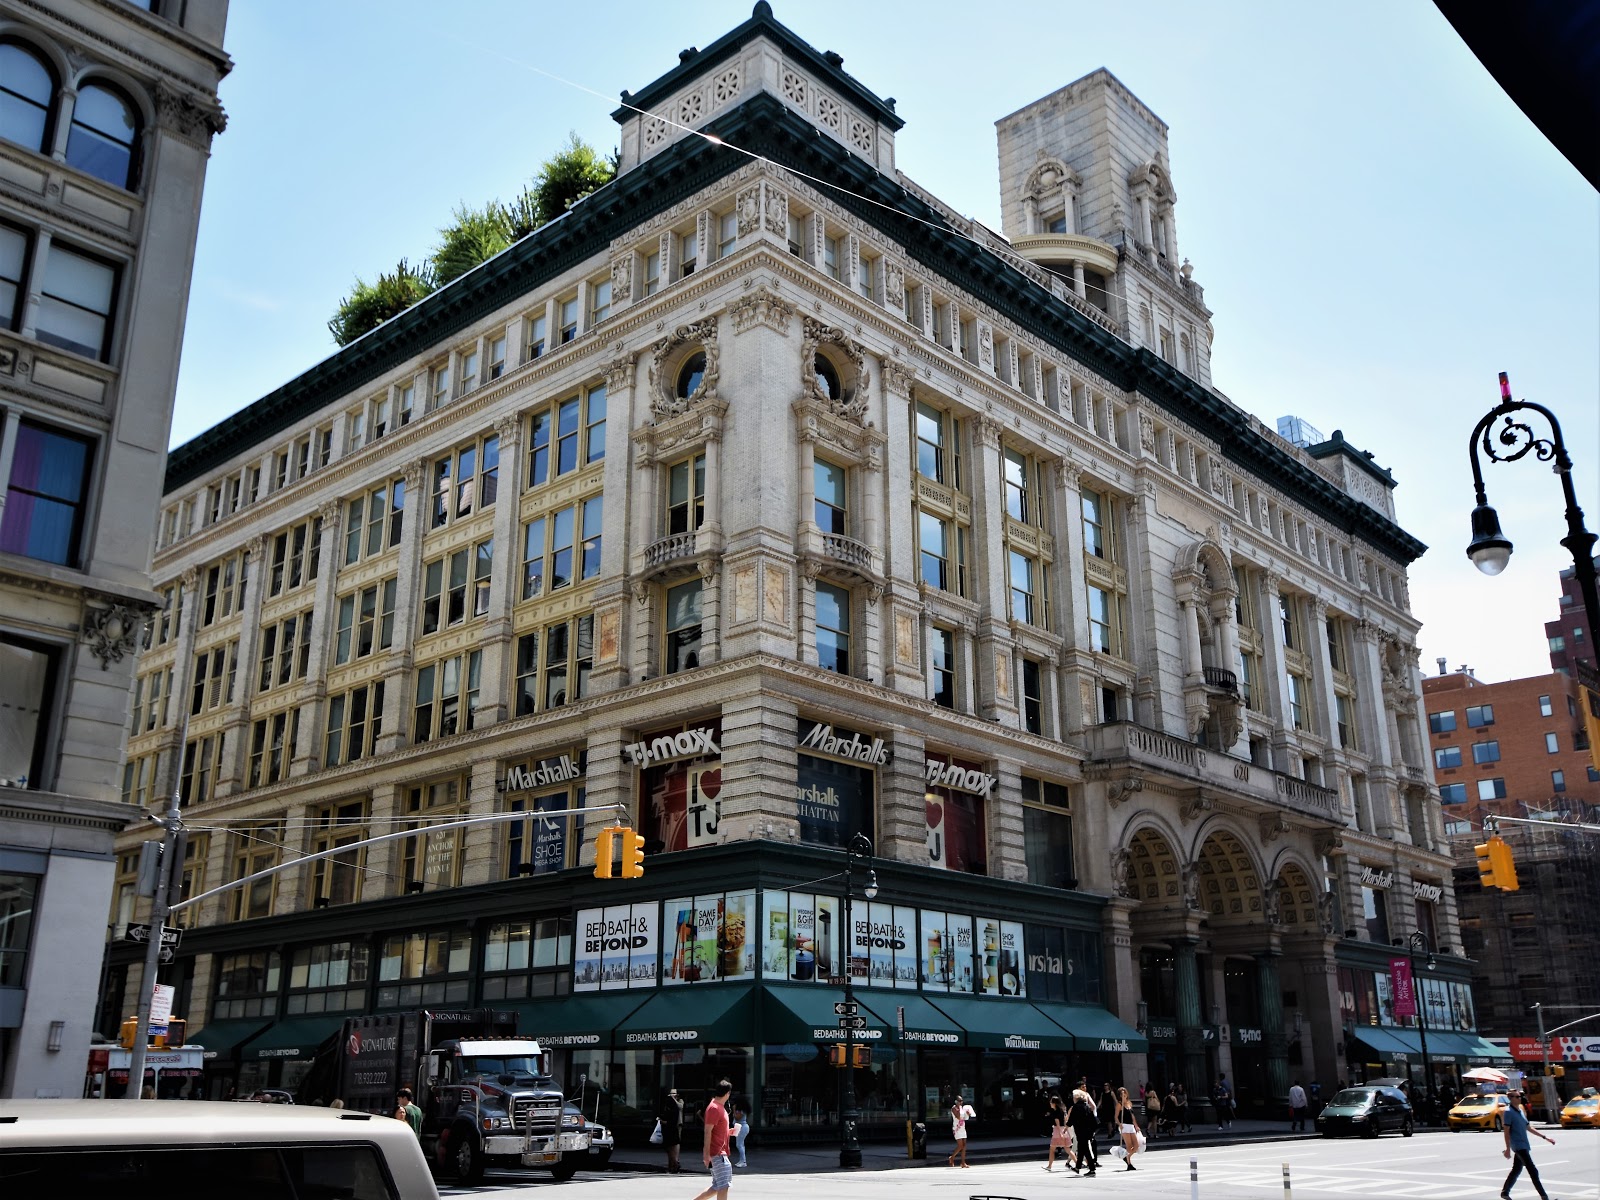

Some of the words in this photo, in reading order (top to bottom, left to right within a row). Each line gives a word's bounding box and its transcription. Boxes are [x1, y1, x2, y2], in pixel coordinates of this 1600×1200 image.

[800, 723, 889, 766] Marshalls
[506, 754, 580, 792] Marshalls
[1234, 763, 1249, 783] 620
[797, 784, 840, 807] arshalls
[797, 804, 840, 822] HATTAN
[537, 831, 562, 843] Marshalls
[427, 841, 454, 852] ANCHOR
[535, 842, 562, 859] SHOE
[427, 854, 437, 863] OF
[438, 851, 451, 861] THE
[534, 859, 548, 867] MEGA
[549, 856, 563, 864] SHOP
[426, 863, 451, 875] AVENUE
[1360, 867, 1394, 888] Marshalls
[698, 908, 716, 919] SAME
[796, 908, 814, 916] WEDDING
[586, 920, 607, 938] BED
[608, 918, 637, 937] BATH
[638, 916, 648, 933] &
[698, 917, 715, 927] DAY
[134, 929, 150, 937] ONE
[855, 920, 873, 935] BED
[873, 922, 897, 938] BATH
[897, 926, 905, 939] &
[957, 927, 971, 935] SAME
[855, 935, 906, 950] BEYOND
[957, 934, 970, 943] DAY
[1002, 933, 1014, 941] SHOP
[585, 935, 648, 952] BEYOND
[1028, 948, 1073, 975] rshals
[434, 1013, 472, 1021] SIGNATURE
[536, 1037, 545, 1045] BED
[545, 1037, 558, 1045] BATH
[563, 1035, 600, 1044] BEYOND
[626, 1033, 638, 1042] BED
[638, 1033, 652, 1042] BATH
[652, 1032, 657, 1041] &
[657, 1031, 698, 1041] BEYOND
[814, 1029, 825, 1039] BED
[825, 1029, 840, 1039] BATH
[845, 1030, 883, 1039] YOND
[909, 1032, 922, 1041] BATH
[926, 1033, 959, 1042] BEYOND
[361, 1036, 396, 1052] SIGNATURE
[1004, 1037, 1022, 1048] WORLD
[1022, 1038, 1041, 1049] MARKET
[1098, 1038, 1129, 1051] Marshalls
[277, 1048, 300, 1056] BEYOND
[353, 1071, 388, 1085] 718.932.2222
